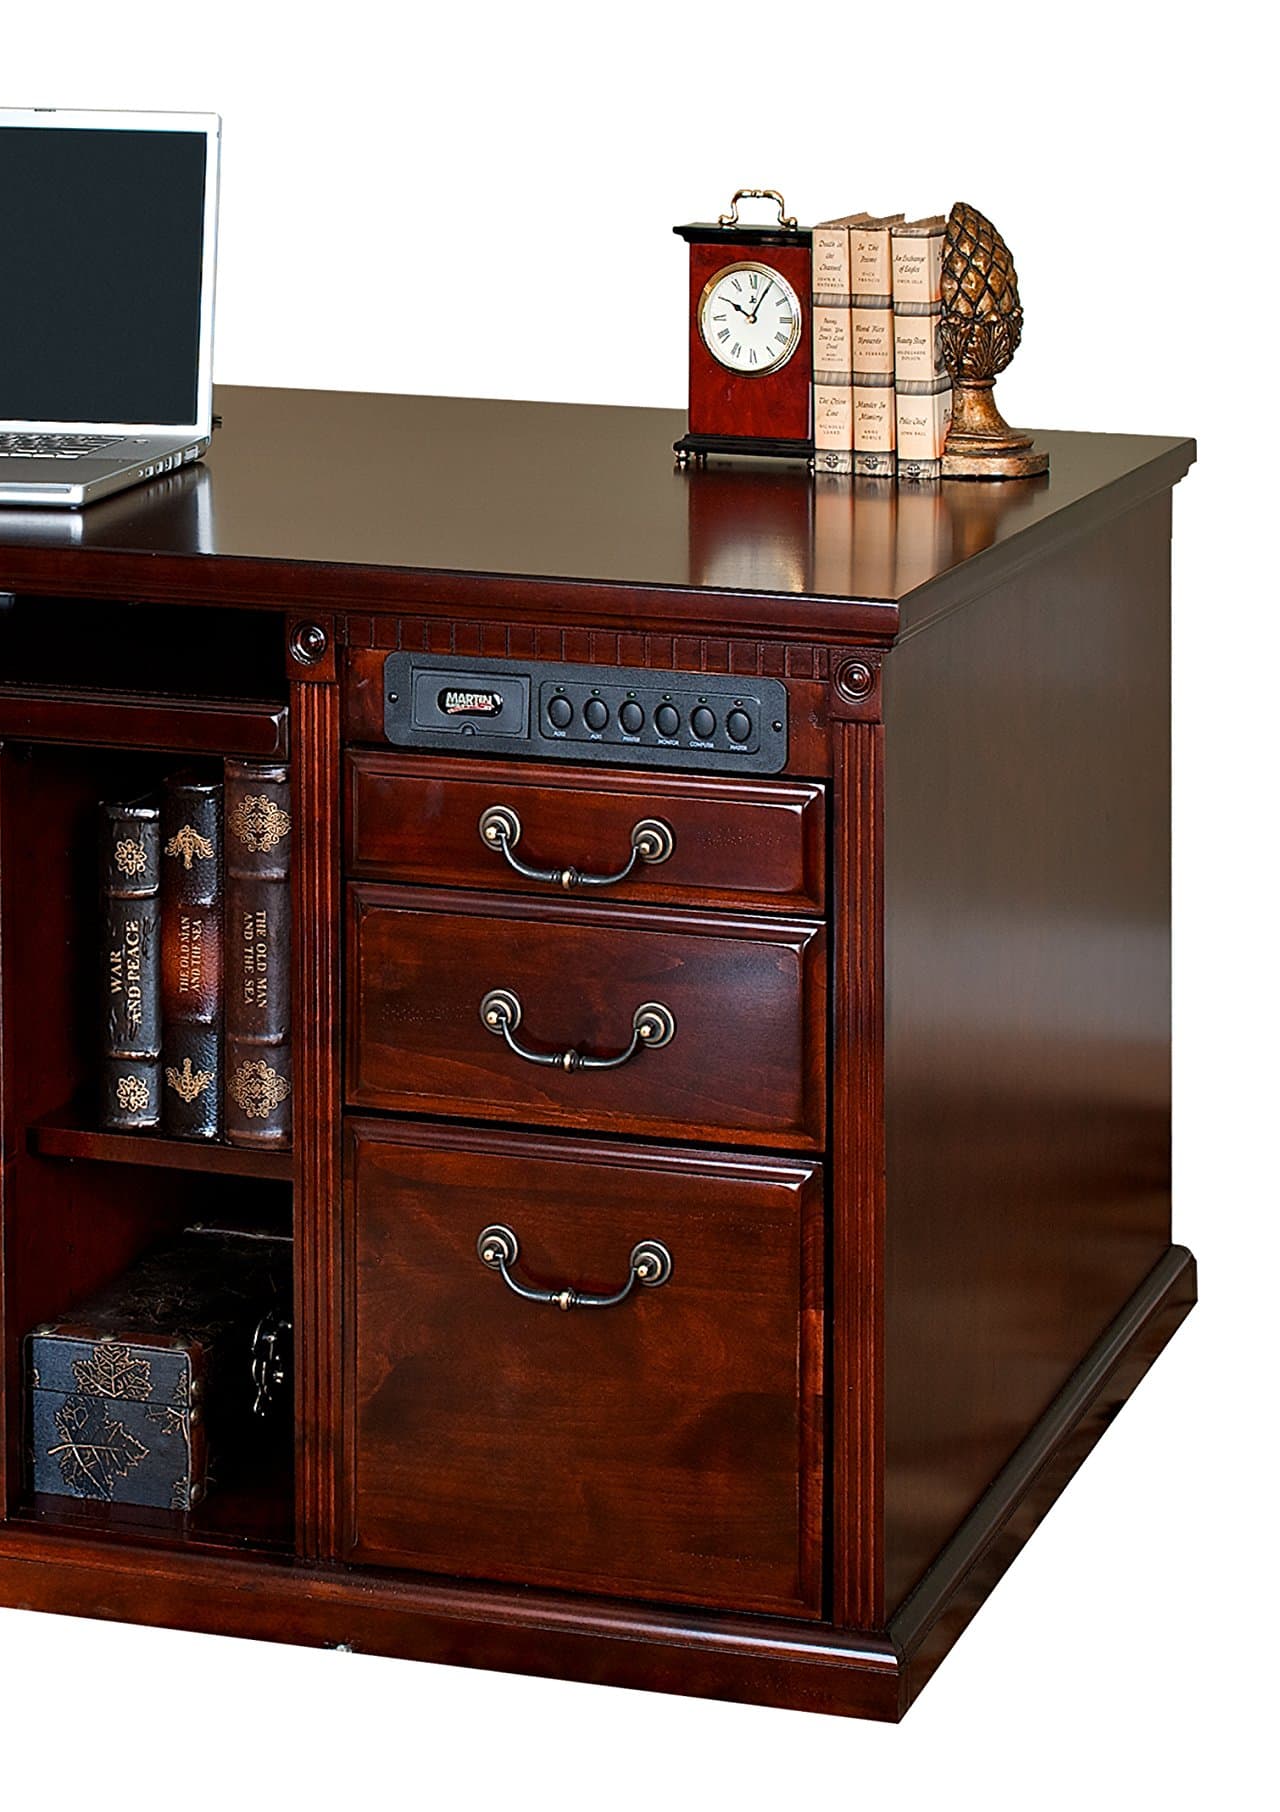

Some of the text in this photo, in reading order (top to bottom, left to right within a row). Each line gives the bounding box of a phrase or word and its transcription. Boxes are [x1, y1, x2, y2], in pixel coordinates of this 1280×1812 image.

[445, 691, 494, 708] MARTIN
[110, 951, 123, 994] WAR
[179, 916, 191, 993] THE OLD MAN
[190, 919, 203, 993] AND THE SEA
[242, 911, 255, 1005] AND THE SEA
[255, 910, 268, 1009] THE OLD MAN
[126, 986, 142, 1025] AND
